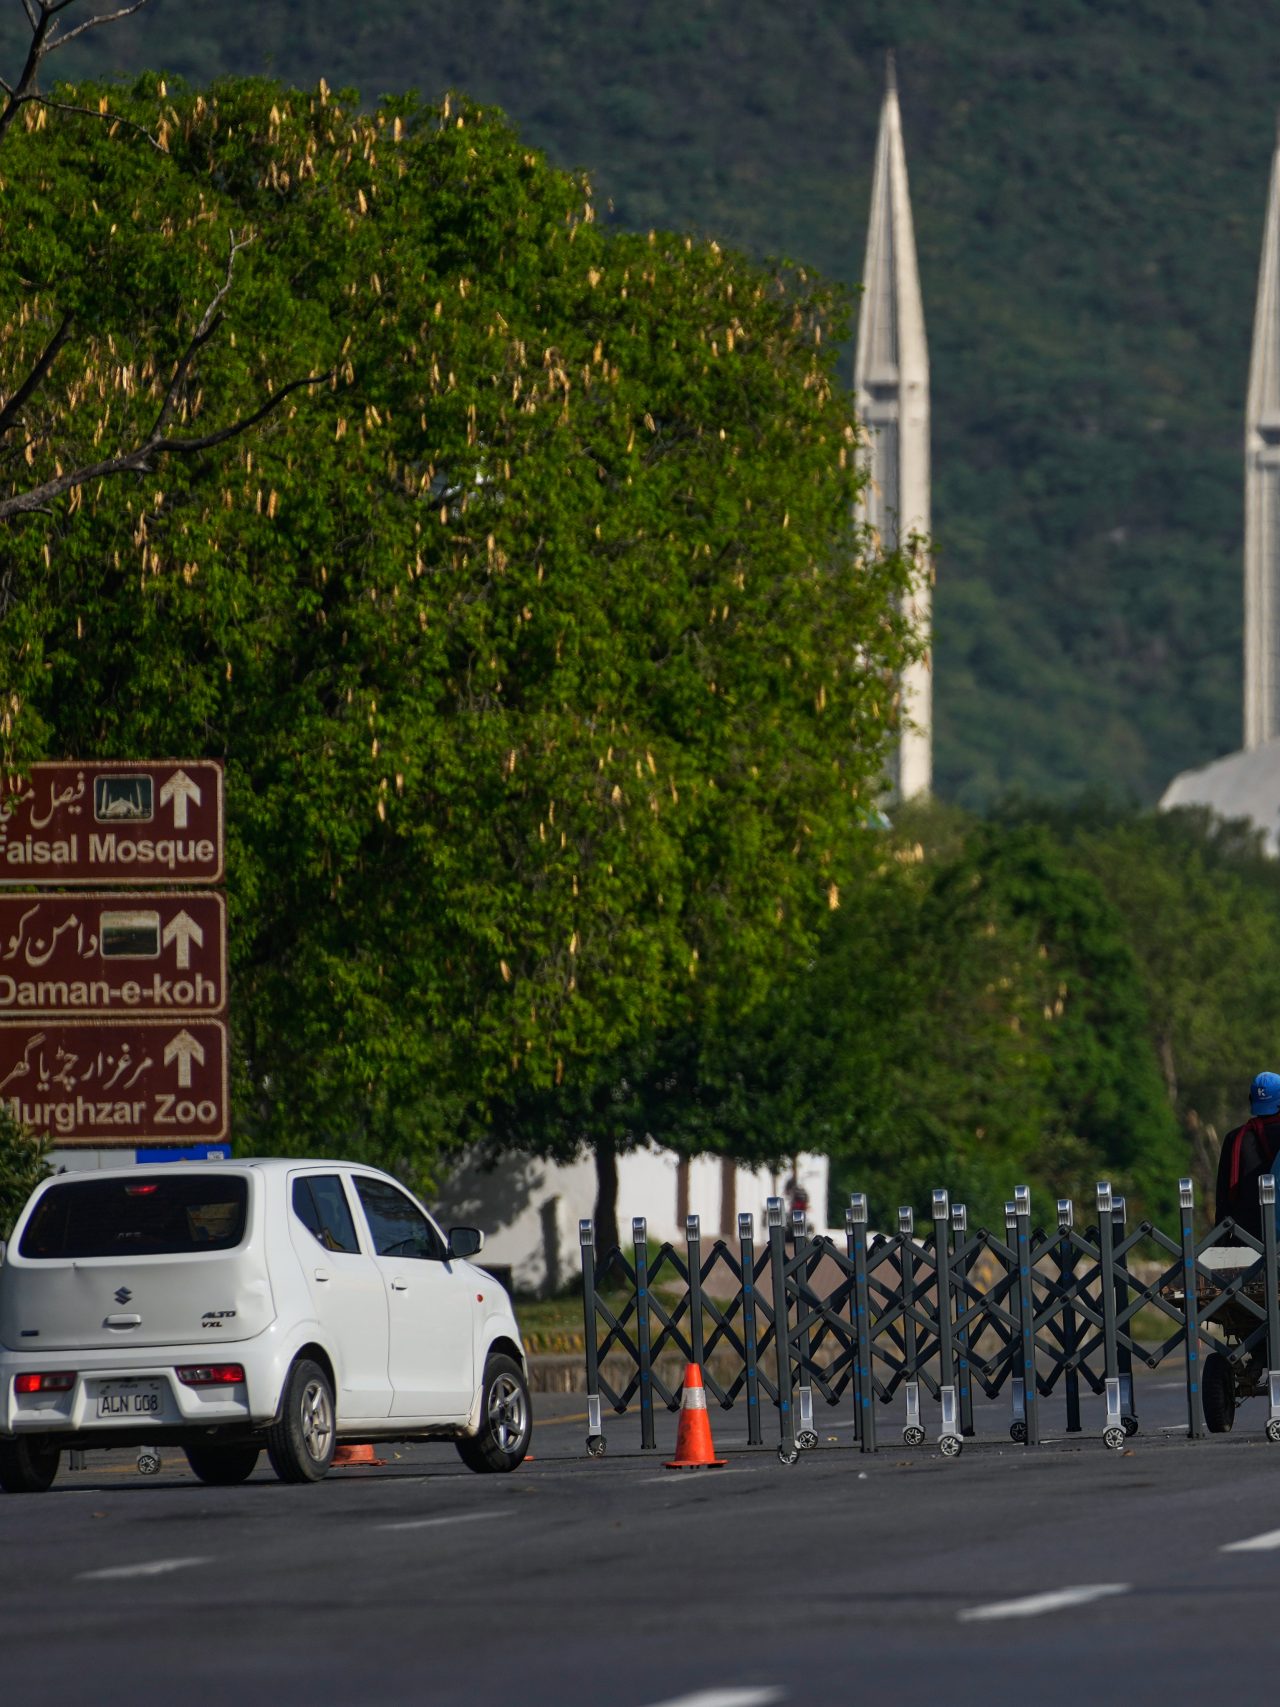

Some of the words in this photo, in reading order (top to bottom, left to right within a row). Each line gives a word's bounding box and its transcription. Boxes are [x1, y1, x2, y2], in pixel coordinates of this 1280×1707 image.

[0, 833, 77, 863] aisal
[88, 833, 215, 869] Mosque
[0, 973, 215, 1006] Daman-e-koh
[153, 1093, 217, 1125] Zoo
[201, 1310, 237, 1319] ALTO
[101, 1395, 128, 1414] ALN
